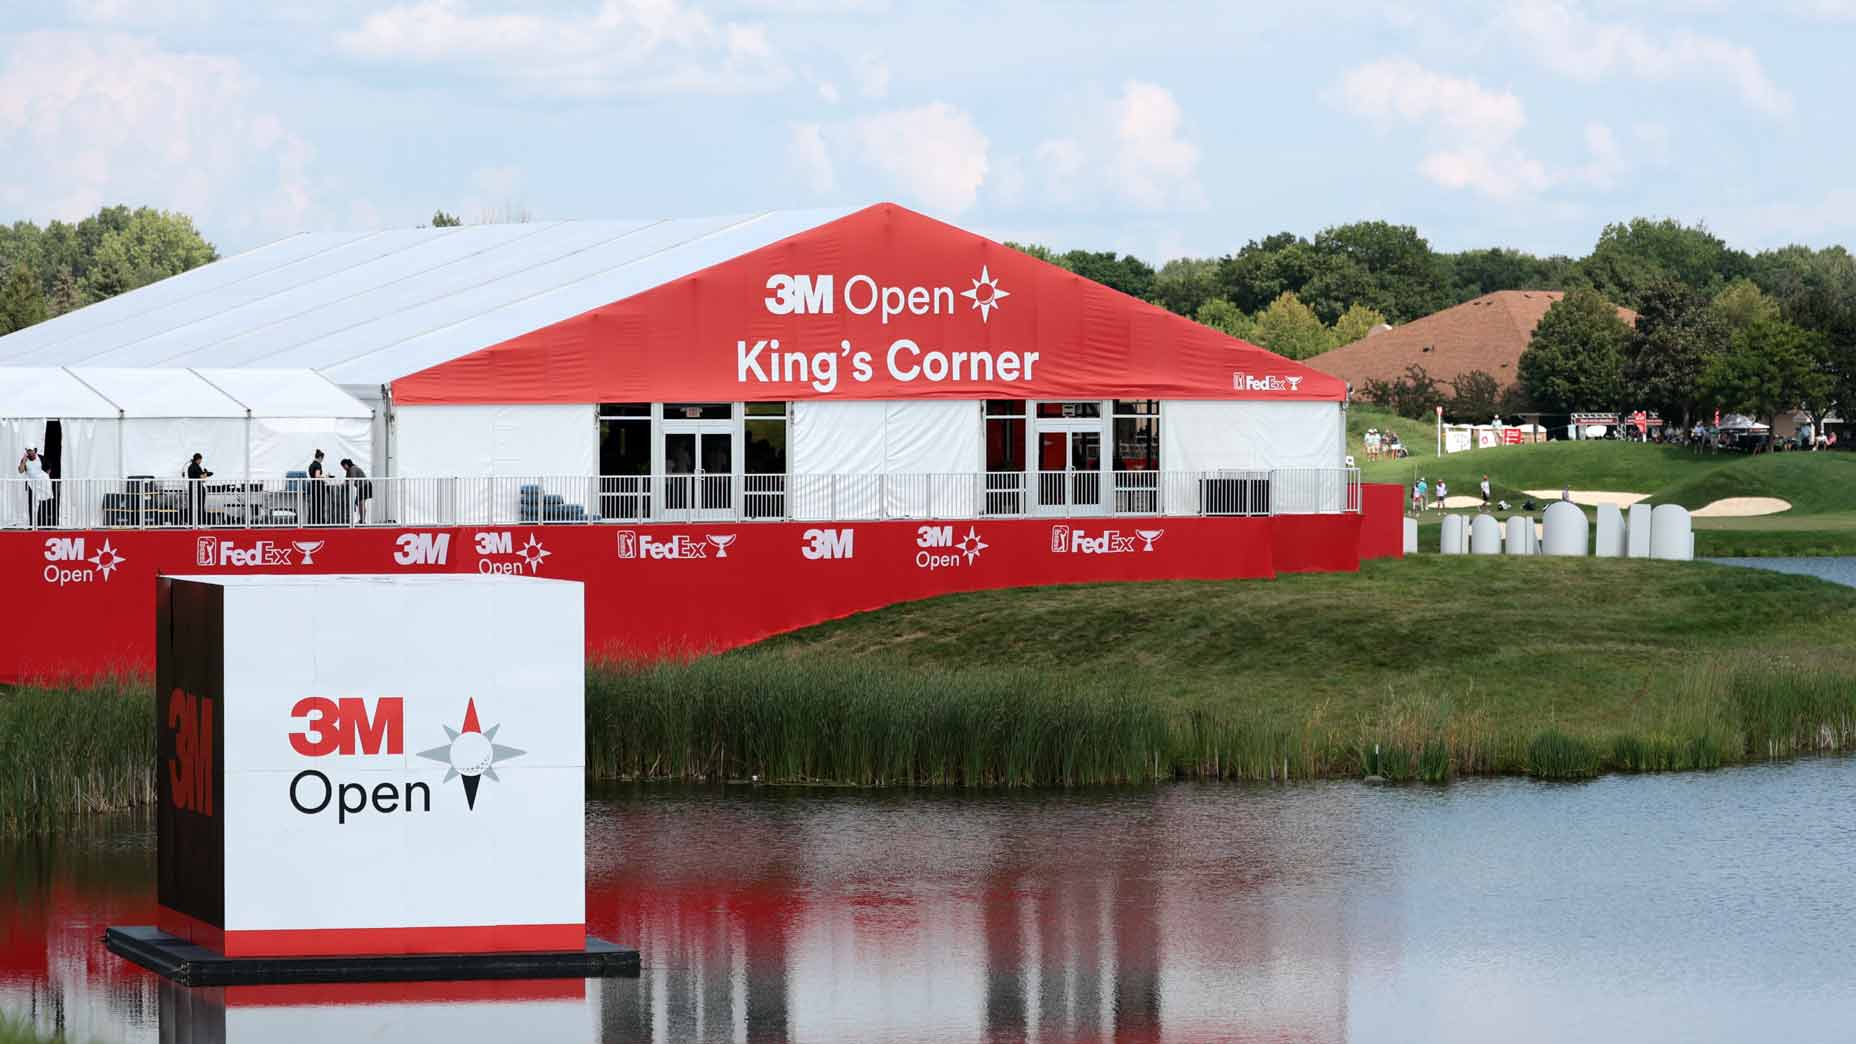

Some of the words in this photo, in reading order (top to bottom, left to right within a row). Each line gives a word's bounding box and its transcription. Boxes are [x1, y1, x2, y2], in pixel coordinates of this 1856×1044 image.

[764, 273, 834, 315] 3M
[844, 274, 955, 324] Open
[737, 339, 873, 393] King’s
[886, 339, 1039, 382] Corner
[1246, 375, 1287, 391] FedEx
[44, 537, 85, 561] 3M
[393, 532, 451, 565] 3M
[475, 531, 513, 555] 3M
[639, 535, 707, 559] FedEx
[801, 528, 854, 560] 3M
[916, 525, 953, 548] 3M
[1071, 529, 1135, 554] FedEx
[220, 540, 292, 566] FedEx
[915, 550, 960, 571] Open
[43, 565, 93, 587] Open
[288, 696, 404, 757] 3M
[168, 687, 213, 817] 3M
[289, 769, 431, 825] Open
